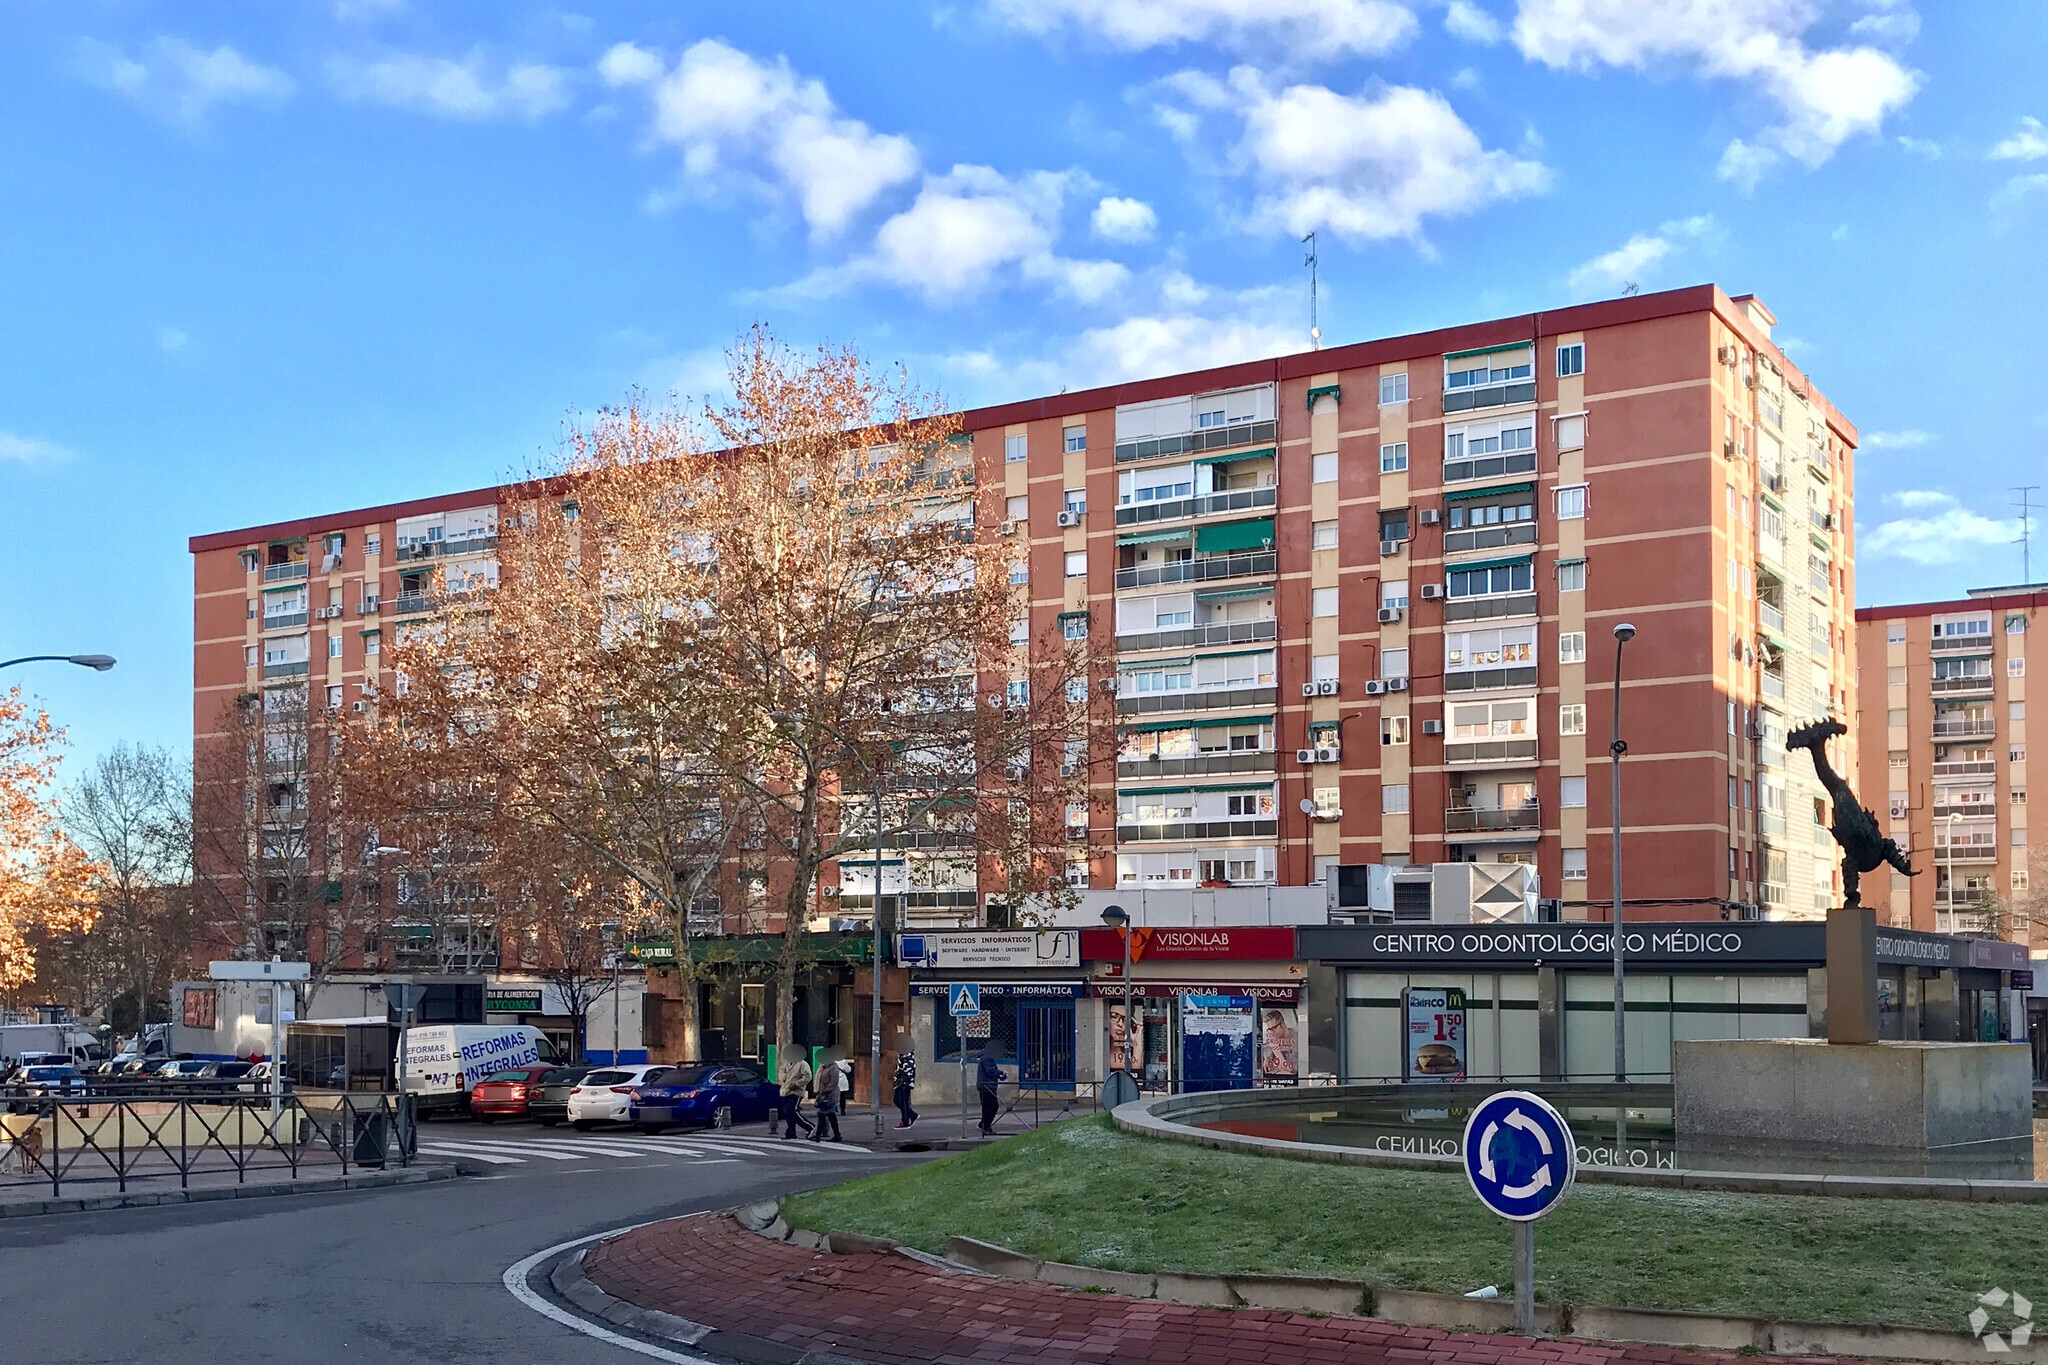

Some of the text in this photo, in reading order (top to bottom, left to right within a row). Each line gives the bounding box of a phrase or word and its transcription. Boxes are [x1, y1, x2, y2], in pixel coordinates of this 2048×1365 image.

[982, 935, 1033, 944] INFORMÁTICOS
[1156, 932, 1230, 946] VISIONLAB
[1373, 928, 1742, 952] CENTRO ODONTOLÓGICO MÉDICO
[1875, 936, 1894, 956] ENTRO
[640, 947, 674, 959] CAJA RURAL
[918, 984, 1073, 995] SERVIC CNICO INFORMÁTICA
[1241, 987, 1293, 998] VISIONLAB
[407, 1044, 446, 1055] EFORMAS
[461, 1031, 527, 1062] REFORMAS
[465, 1047, 539, 1082] INTEGRALES
